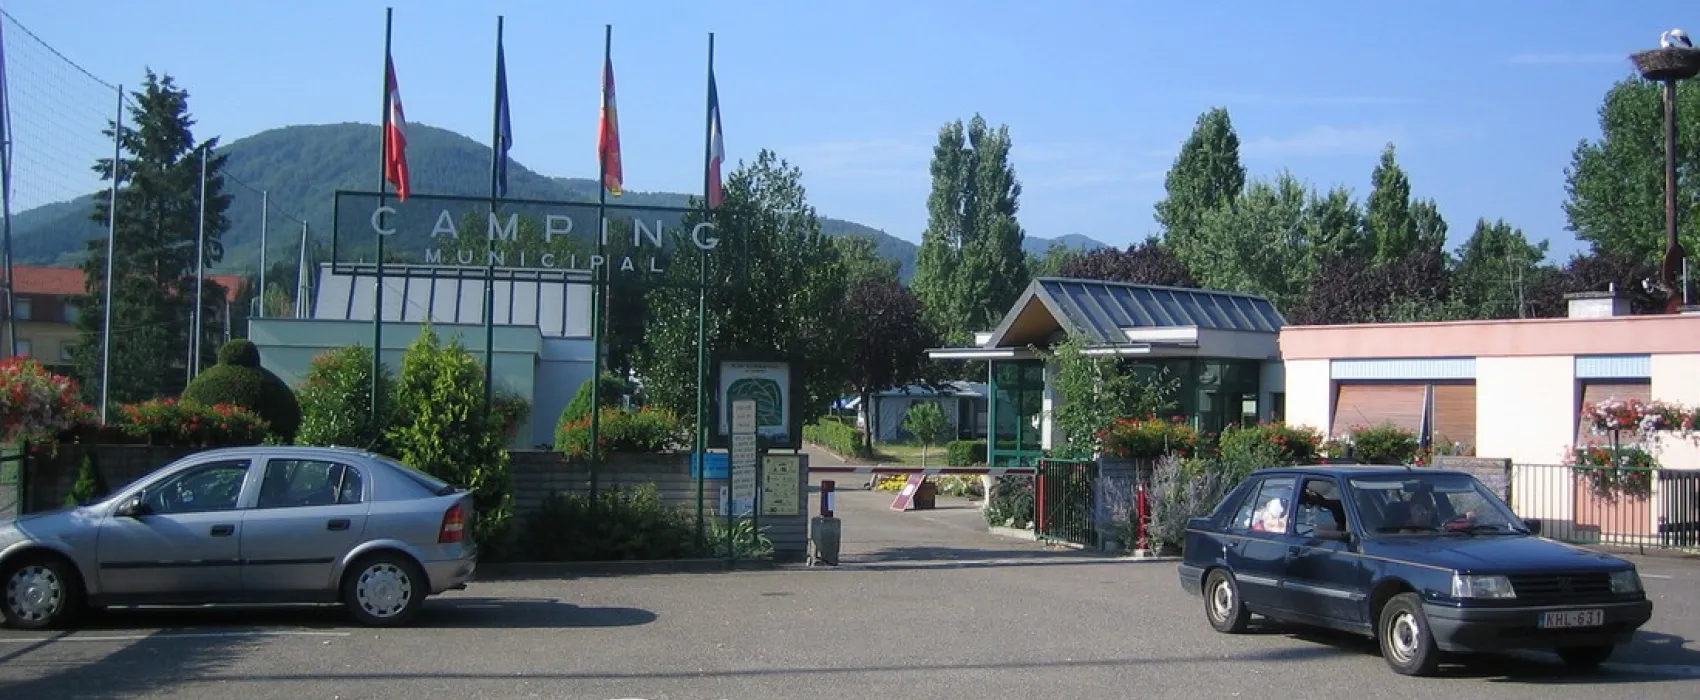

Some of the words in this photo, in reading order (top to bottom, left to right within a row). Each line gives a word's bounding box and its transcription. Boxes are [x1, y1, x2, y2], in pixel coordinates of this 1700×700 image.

[371, 207, 720, 250] CAMPING
[425, 248, 664, 272] MUNICIPAL
[1546, 610, 1602, 626] KHL-631
